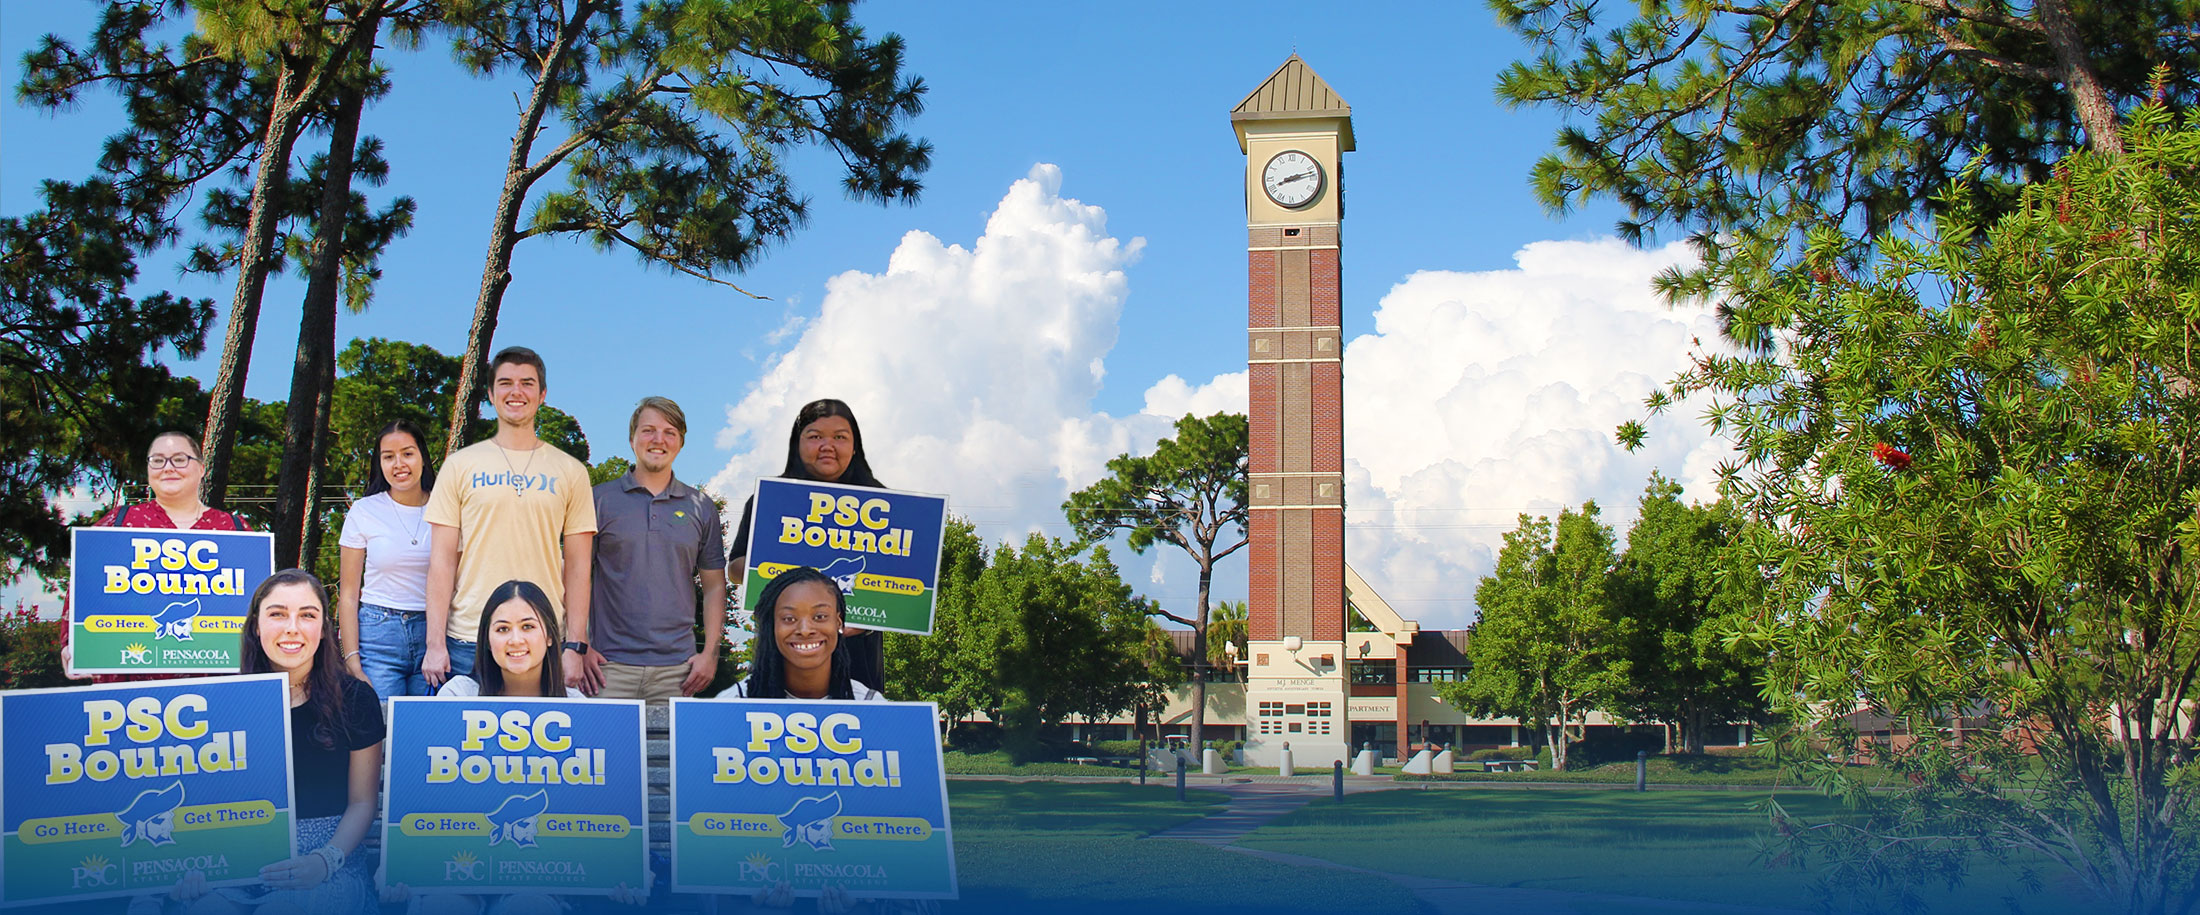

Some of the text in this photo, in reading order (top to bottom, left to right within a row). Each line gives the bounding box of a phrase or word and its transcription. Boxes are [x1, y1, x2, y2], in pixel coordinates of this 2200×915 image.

[473, 471, 536, 489] Hurley
[806, 492, 891, 530] PSC
[779, 516, 914, 557] Bound!
[131, 538, 219, 572] PSC
[768, 566, 783, 576] Go
[104, 565, 245, 596] Bound!
[862, 578, 920, 592] Get There.
[846, 604, 887, 618] SACOLA
[96, 620, 148, 629] Go Here.
[199, 620, 244, 629] Get The
[120, 650, 152, 664] PSC
[162, 650, 230, 660] PENSACOLA
[83, 694, 209, 746] PSC
[462, 710, 572, 752] PSC
[746, 711, 863, 754] PSC
[45, 730, 248, 785] Bound!
[426, 746, 606, 786] Bound!
[712, 747, 902, 788] Bound!
[184, 808, 270, 825] Get There.
[414, 818, 480, 831] Go Here.
[704, 818, 772, 832] Go Here.
[35, 822, 110, 837] Go Here.
[546, 820, 625, 833] Get There.
[842, 822, 926, 836] Get There.
[132, 854, 229, 876] PENSACOLA
[443, 860, 485, 881] PSC
[498, 861, 586, 875] PENSACOLA
[737, 861, 780, 883] PSC
[794, 864, 888, 878] PENSACOLA
[72, 863, 118, 889] PSC
